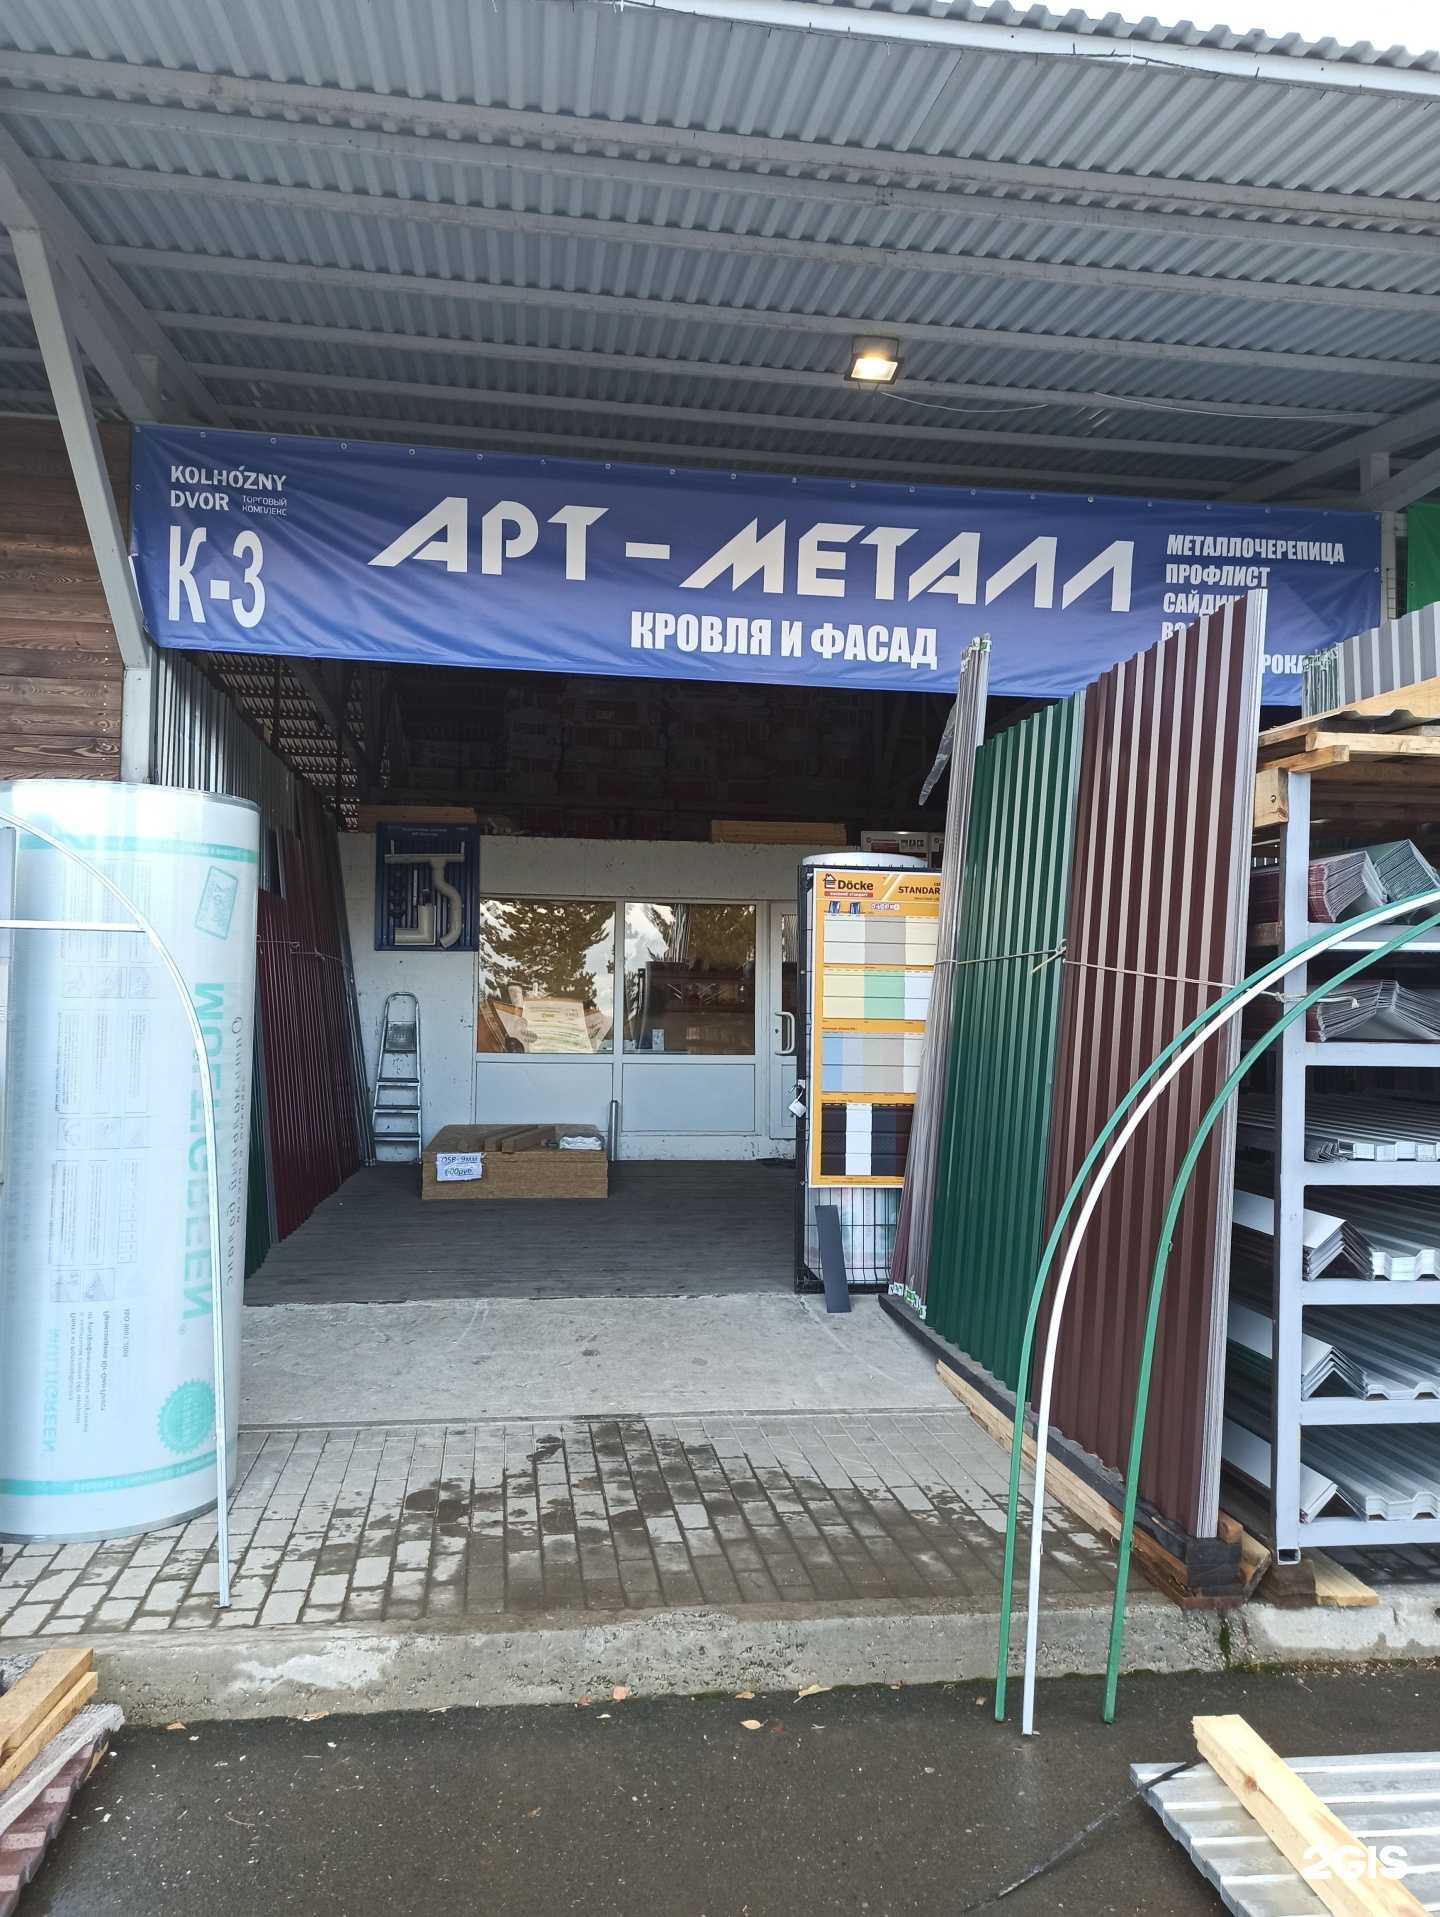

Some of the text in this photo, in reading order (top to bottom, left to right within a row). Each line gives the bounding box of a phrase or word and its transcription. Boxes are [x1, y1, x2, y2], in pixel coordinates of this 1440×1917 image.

[171, 466, 287, 491] KOLHÓZNY
[171, 491, 229, 511] DVOR
[242, 505, 287, 516] КОМПЛЕКС
[243, 495, 287, 507] ТОРГОВЫЙ
[1167, 534, 1345, 564] МЕТАЛЛОЧЕРЕПИЦА
[1165, 563, 1271, 588] ПРОФЛИСТ
[631, 611, 938, 670] КРОВЛЯ И ФАСАД
[837, 879, 874, 891] Döcke
[898, 886, 941, 896] STANDAR
